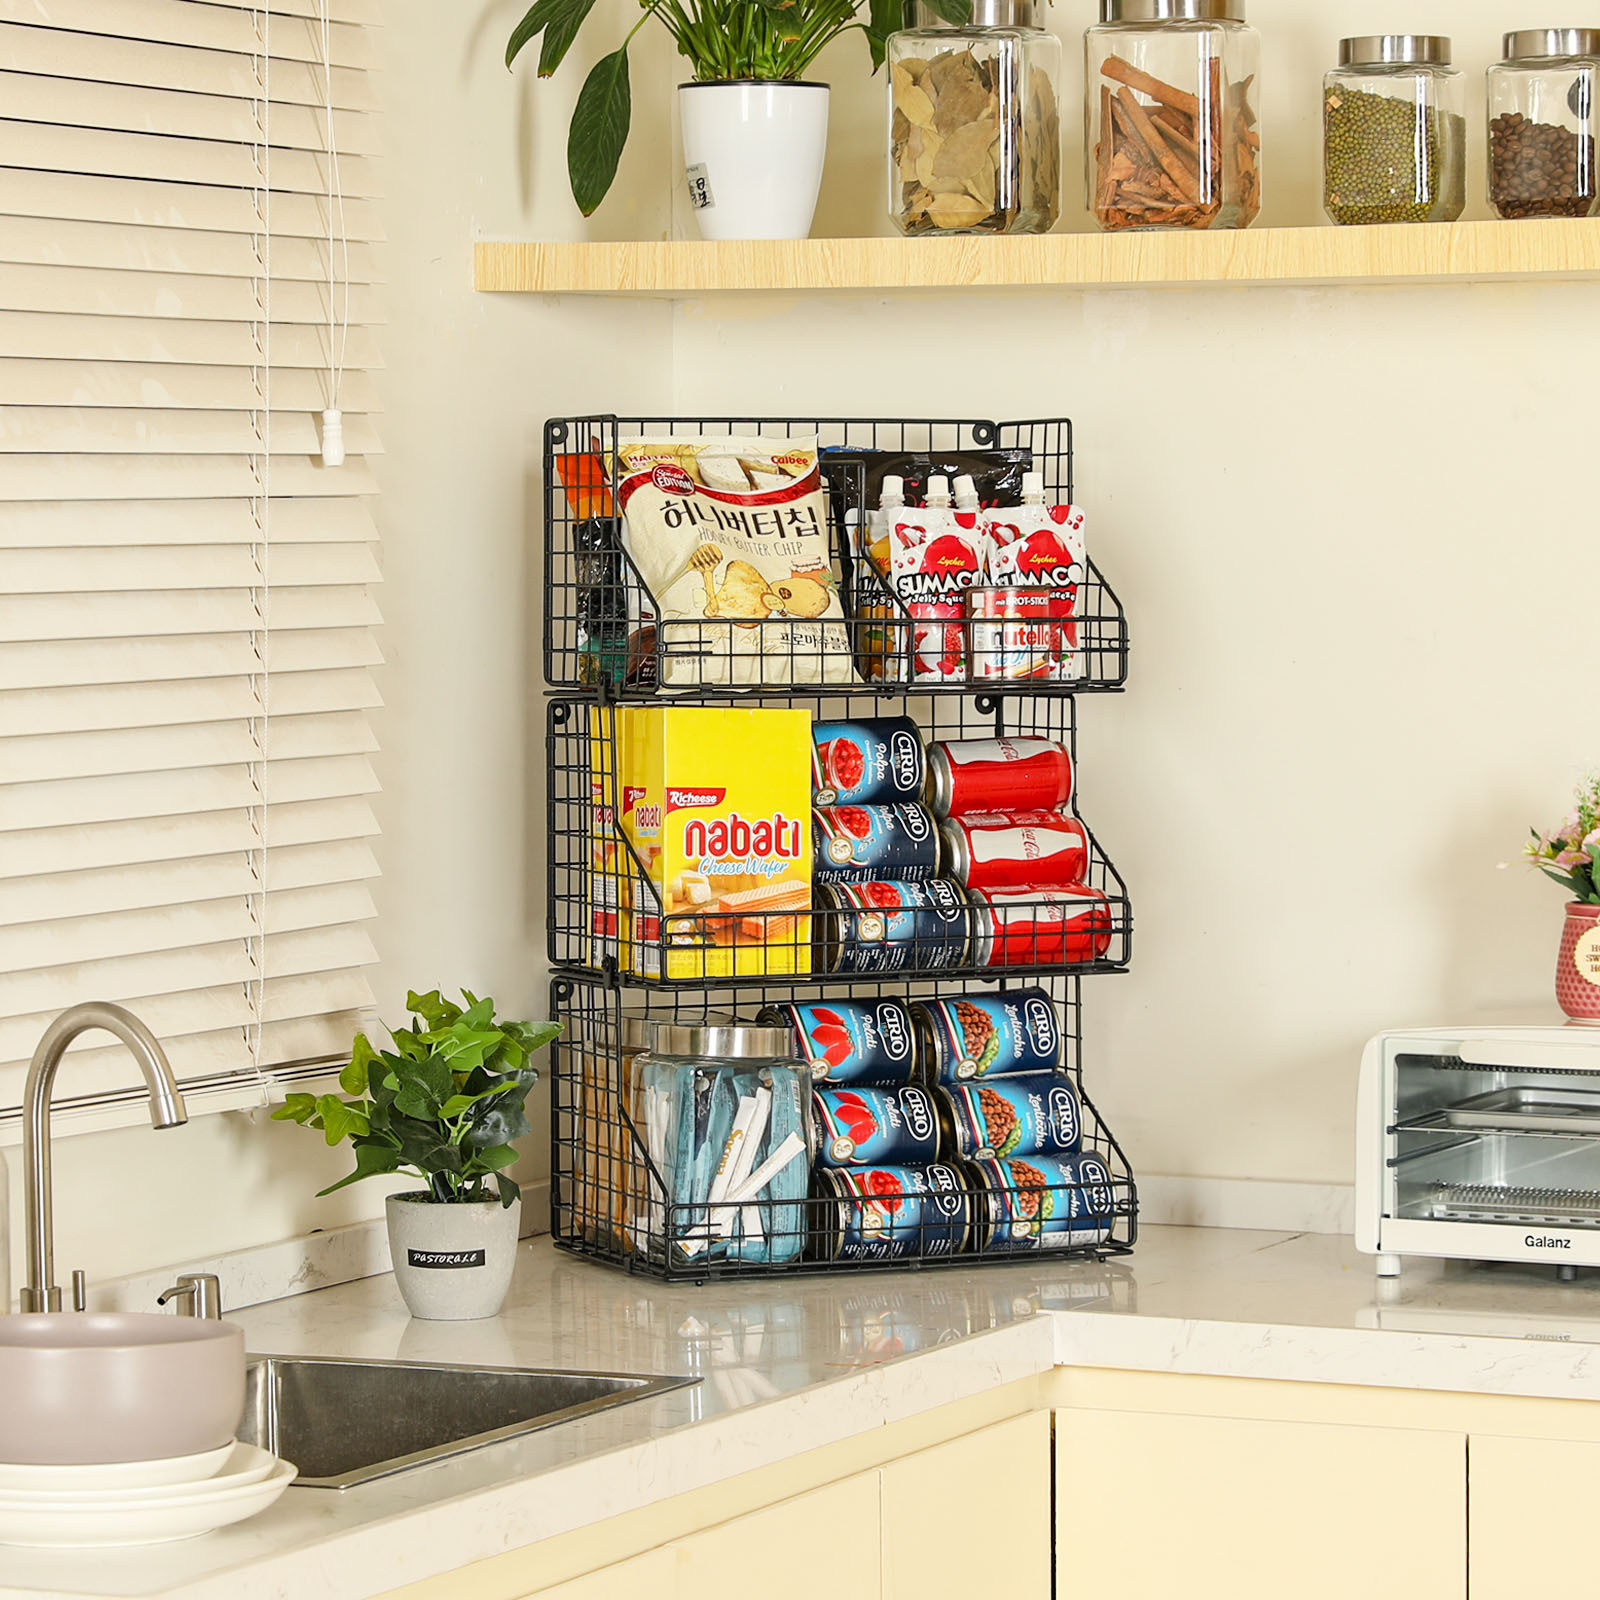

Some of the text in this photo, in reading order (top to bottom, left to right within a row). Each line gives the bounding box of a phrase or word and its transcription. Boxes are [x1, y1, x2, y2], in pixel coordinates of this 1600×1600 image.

[656, 469, 685, 479] Special
[770, 455, 808, 465] Calbee
[657, 477, 693, 490] EDITION
[659, 499, 820, 539] 허니버터칩
[698, 527, 803, 557] HONEY BUTTER CHIP
[936, 556, 965, 567] Lychee
[1029, 553, 1057, 564] Lychee
[912, 594, 938, 605] Jelly
[870, 742, 889, 782] Polpa
[897, 736, 915, 785] CIRIO
[669, 791, 717, 807] Richeese
[635, 803, 662, 828] nabati
[685, 813, 800, 858] nabati
[699, 857, 788, 877] Cheese Wafer
[861, 1014, 878, 1050] Pelati
[883, 1007, 905, 1054] CIRIO
[1004, 1003, 1026, 1059] Lenticchie
[1031, 1003, 1051, 1051] CIRIO
[882, 1096, 902, 1129] Pelati
[905, 1090, 929, 1134] CIRIO
[1028, 1093, 1048, 1149] Lenticchie
[1055, 1093, 1073, 1142] CIRIO
[1524, 1235, 1571, 1249] Galanz
[413, 1253, 477, 1265] PASTORALE
